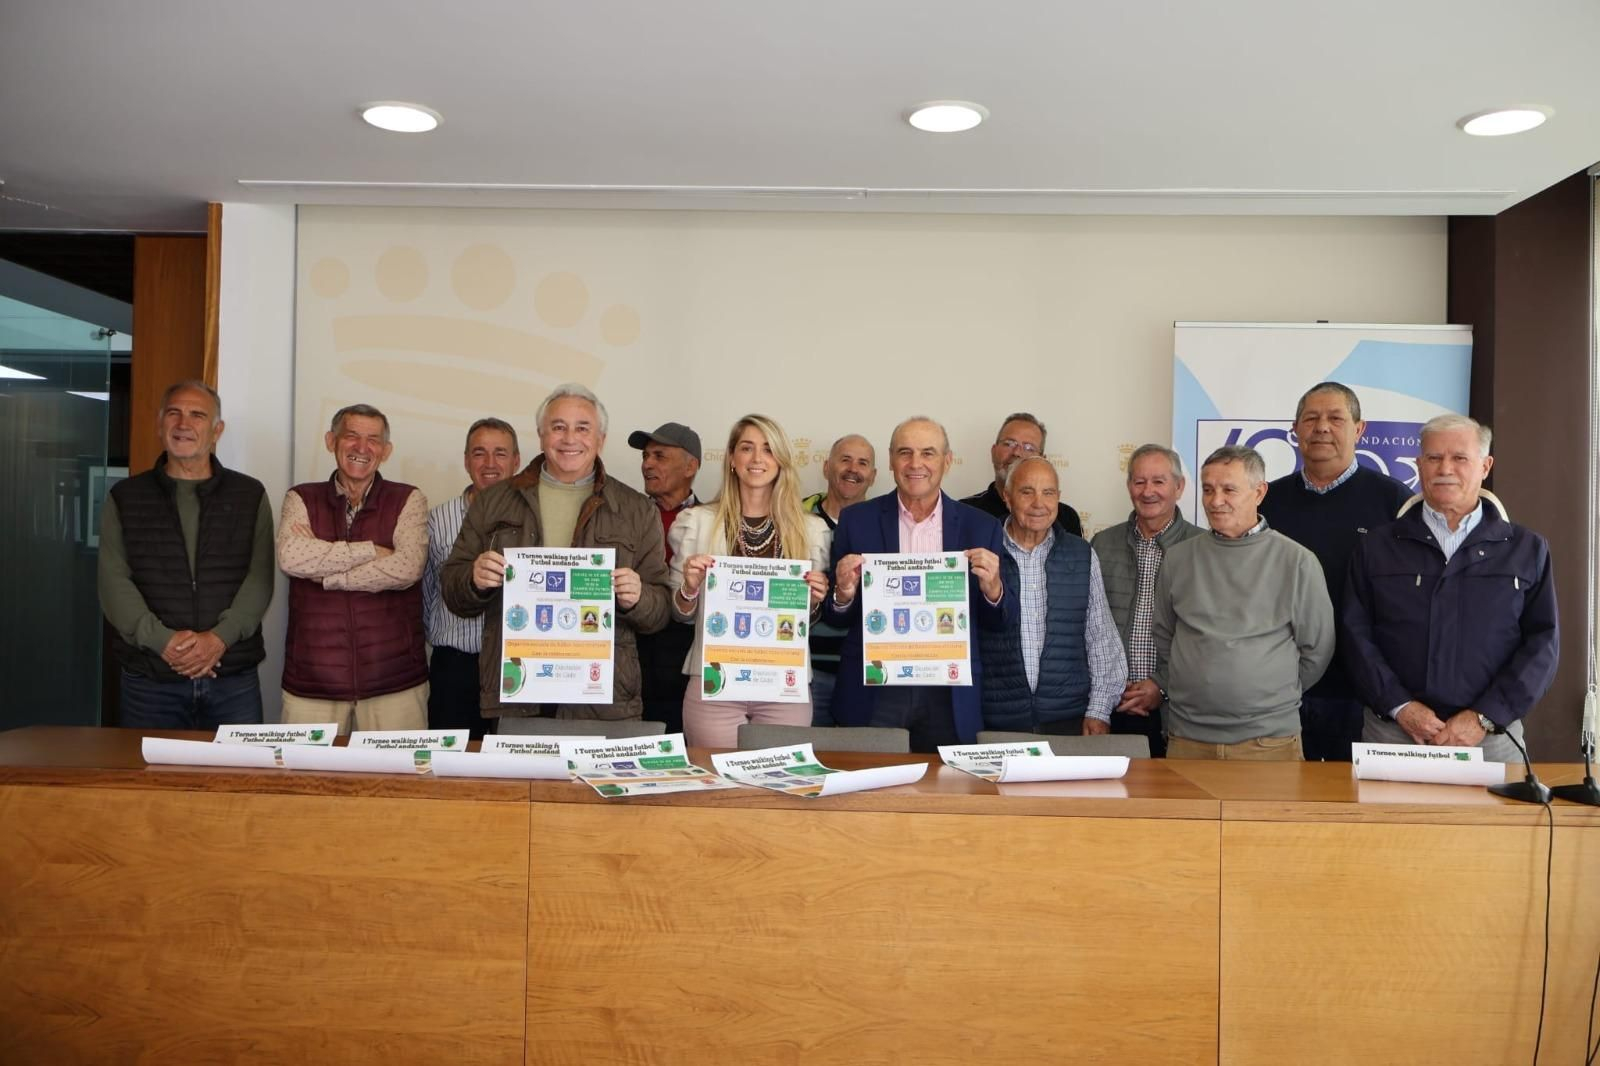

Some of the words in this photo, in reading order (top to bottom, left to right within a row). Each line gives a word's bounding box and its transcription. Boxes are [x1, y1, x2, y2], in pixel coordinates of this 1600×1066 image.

[744, 563, 768, 571] walking
[605, 745, 631, 753] walking
[1398, 750, 1427, 758] walking
